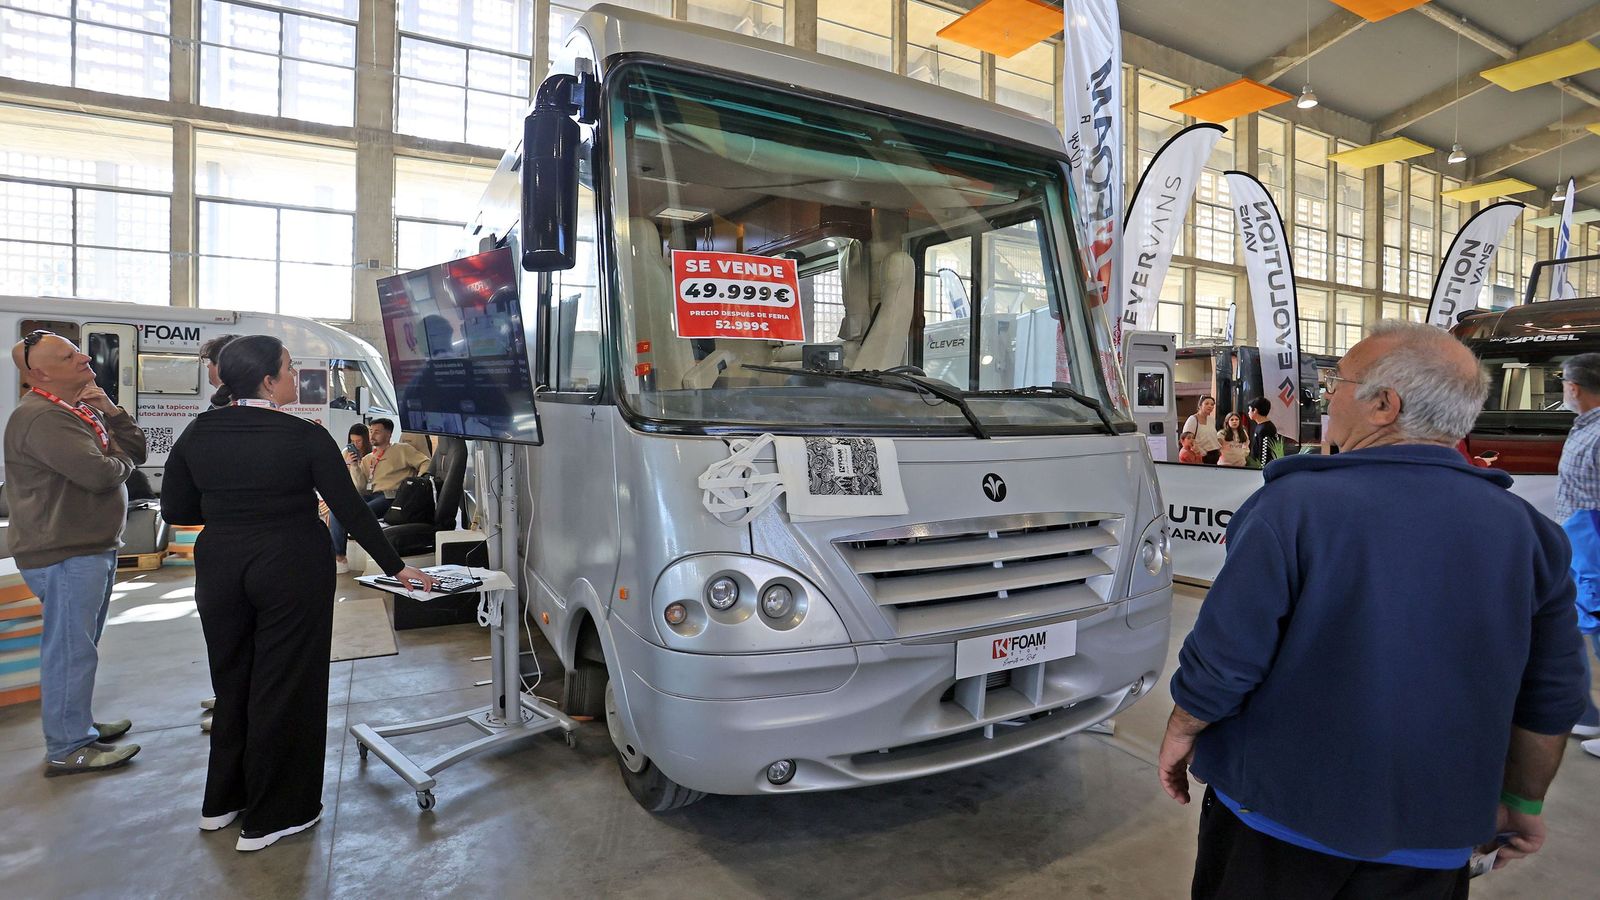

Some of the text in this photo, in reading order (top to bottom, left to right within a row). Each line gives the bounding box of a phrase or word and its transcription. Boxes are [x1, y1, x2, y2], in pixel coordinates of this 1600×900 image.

[685, 259, 784, 278] SE VENDE
[1469, 243, 1495, 285] VANS
[684, 282, 790, 303] 49.999€
[721, 309, 755, 318] DESPUÉS
[715, 320, 770, 331] 52.999€
[929, 339, 965, 349] CLEVER
[1168, 527, 1226, 544] ARAV
[993, 632, 1046, 659] K'FOAM
